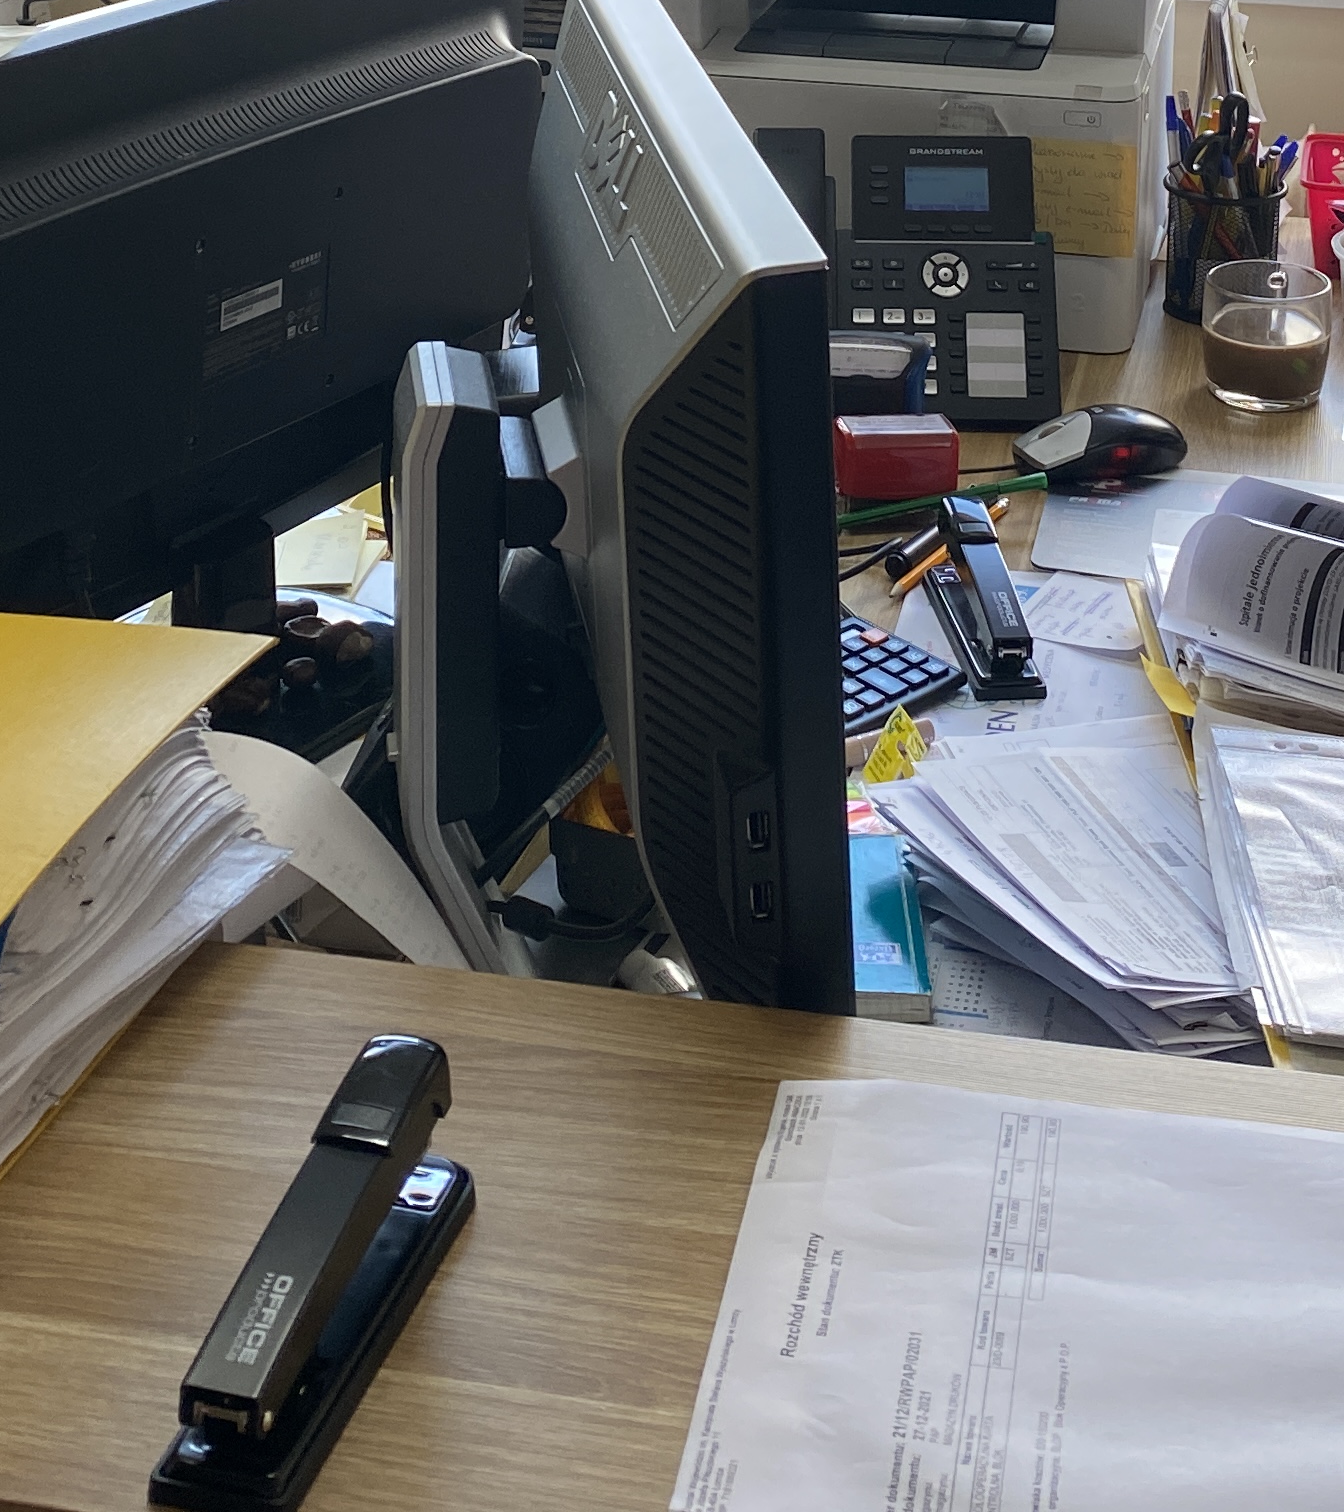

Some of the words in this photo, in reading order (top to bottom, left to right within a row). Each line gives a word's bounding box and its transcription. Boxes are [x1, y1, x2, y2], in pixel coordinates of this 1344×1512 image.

[909, 147, 983, 156] GRANDSTREAM
[998, 591, 1019, 627] OFFICE
[985, 709, 1019, 735] EN
[237, 1275, 294, 1365] OFFICE
[781, 1303, 805, 1357] Rozchód
[796, 1232, 824, 1302] wewnętrzny
[817, 1317, 830, 1337] Stan
[832, 1248, 844, 1266] ZTK
[886, 1442, 905, 1503] dokumentu:
